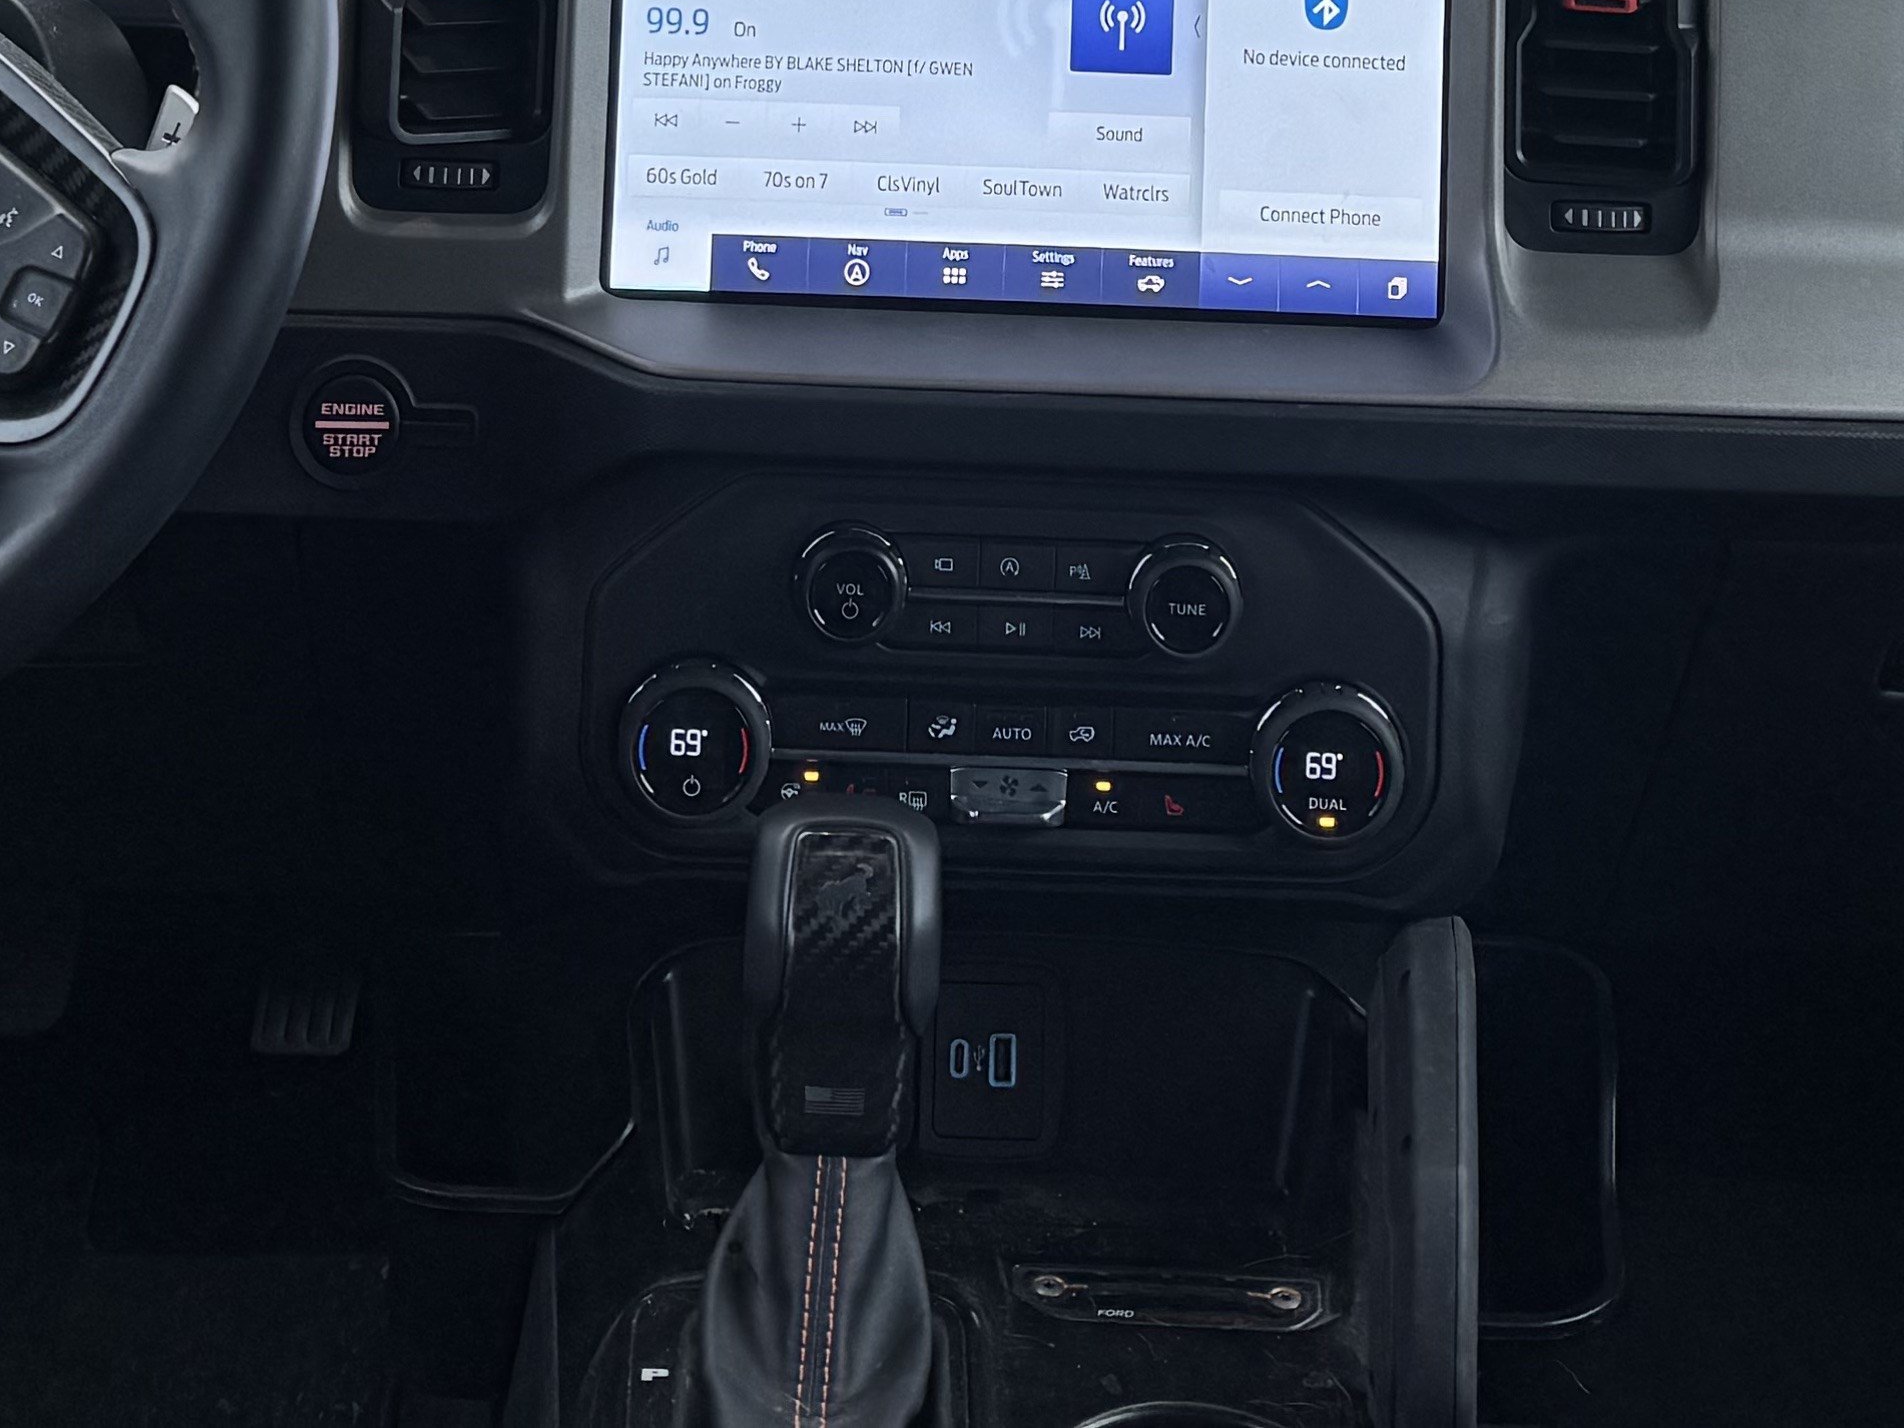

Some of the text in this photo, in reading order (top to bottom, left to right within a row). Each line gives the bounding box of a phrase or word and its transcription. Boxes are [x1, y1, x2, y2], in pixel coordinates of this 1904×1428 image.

[646, 5, 757, 39] 99.9 On
[643, 50, 689, 70] Happy
[691, 52, 762, 71] Anywhere
[764, 54, 784, 70] BY
[786, 54, 834, 73] BLAKE
[836, 56, 904, 75] SHELTON
[928, 60, 974, 77] GWEN
[1242, 48, 1408, 74] No device connected
[642, 71, 783, 93] STEFANI] on Froggy
[1095, 124, 1144, 145] Sound
[645, 167, 718, 187] 60s Gold
[763, 170, 828, 190] 70s on 7
[1102, 183, 1170, 204] Watrclrs
[1259, 204, 1383, 229] Connect Phone
[645, 219, 680, 234] Audio
[742, 239, 778, 255] Phone
[847, 243, 869, 258] Nav
[942, 247, 970, 263] Apps
[1031, 250, 1076, 266] Settings
[1127, 253, 1175, 270] Features
[26, 292, 43, 308] OK
[320, 402, 385, 416] ENGINE
[322, 433, 383, 447] START
[329, 445, 377, 458] STOP
[836, 582, 865, 597] VOL
[1167, 602, 1207, 618] TUNE
[819, 721, 845, 733] MAX
[992, 727, 1032, 741] AUTO
[1149, 733, 1212, 749] MAX A/C
[1093, 800, 1119, 815] A/C
[1307, 797, 1348, 812] DUAL
[640, 1368, 669, 1382] P
